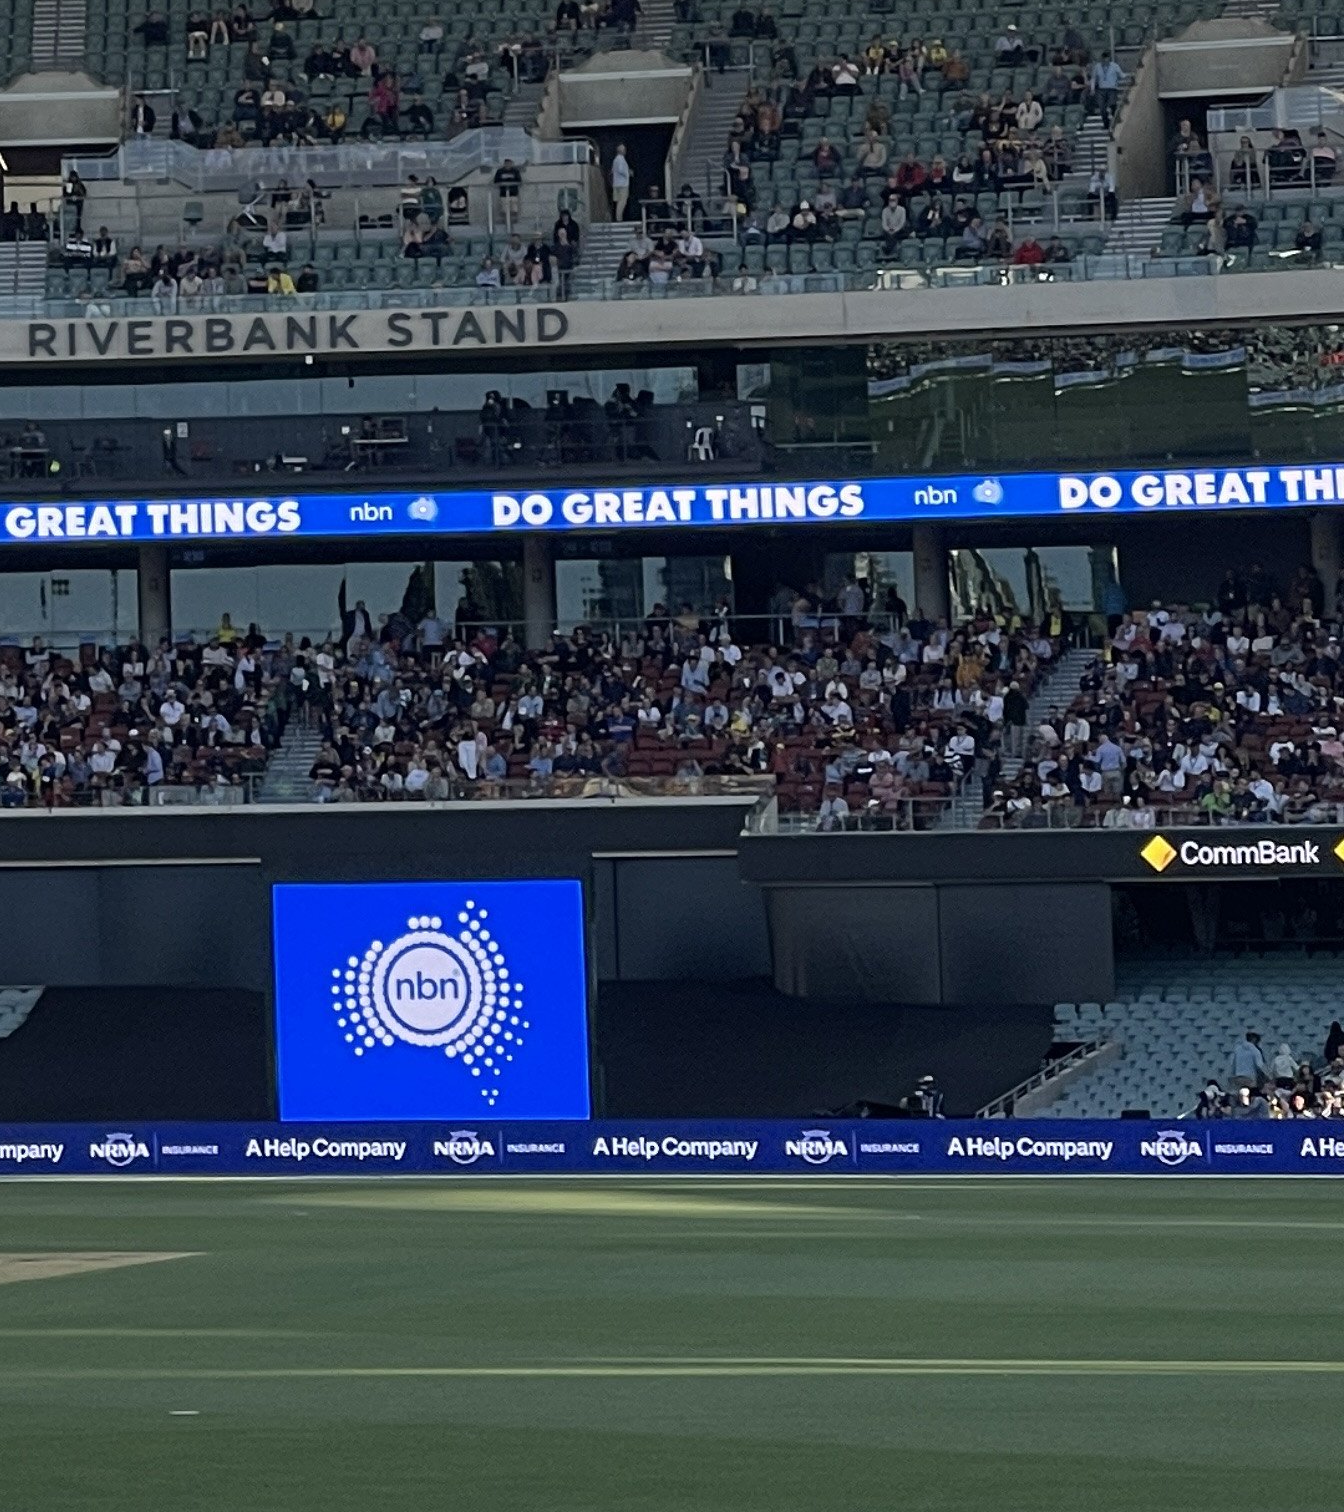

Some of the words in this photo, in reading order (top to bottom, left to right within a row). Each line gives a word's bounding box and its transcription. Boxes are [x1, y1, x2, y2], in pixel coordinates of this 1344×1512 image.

[28, 314, 360, 357] RIVERBANK
[386, 307, 569, 346] STAND
[914, 485, 958, 505] nbn
[1059, 478, 1122, 512] DO
[1131, 472, 1270, 509] GREAT
[350, 502, 393, 522] nbn
[492, 493, 553, 526] DO
[562, 489, 696, 525] GREAT
[705, 484, 864, 520] THINGS
[5, 504, 138, 539] GREAT
[146, 500, 301, 535] THINGS
[1180, 840, 1320, 865] CommBank
[395, 970, 459, 1001] nbn
[90, 1142, 150, 1157] NRMA
[161, 1145, 220, 1155] INSURANCE
[246, 1139, 263, 1157] A
[264, 1137, 310, 1161] Help
[312, 1138, 406, 1161] Company
[433, 1140, 495, 1156] NRMA
[507, 1143, 565, 1153] INSURANCE
[593, 1137, 610, 1156] A
[612, 1136, 660, 1160] Help
[661, 1136, 758, 1160] Company
[785, 1140, 848, 1156] NRMA
[860, 1143, 919, 1153] INSURANCE
[947, 1137, 965, 1156] A
[966, 1136, 1015, 1160] Help
[1016, 1137, 1113, 1161] Company
[1140, 1141, 1203, 1157] NRMA
[1215, 1144, 1273, 1154] INSURANCE
[1300, 1137, 1318, 1157] A
